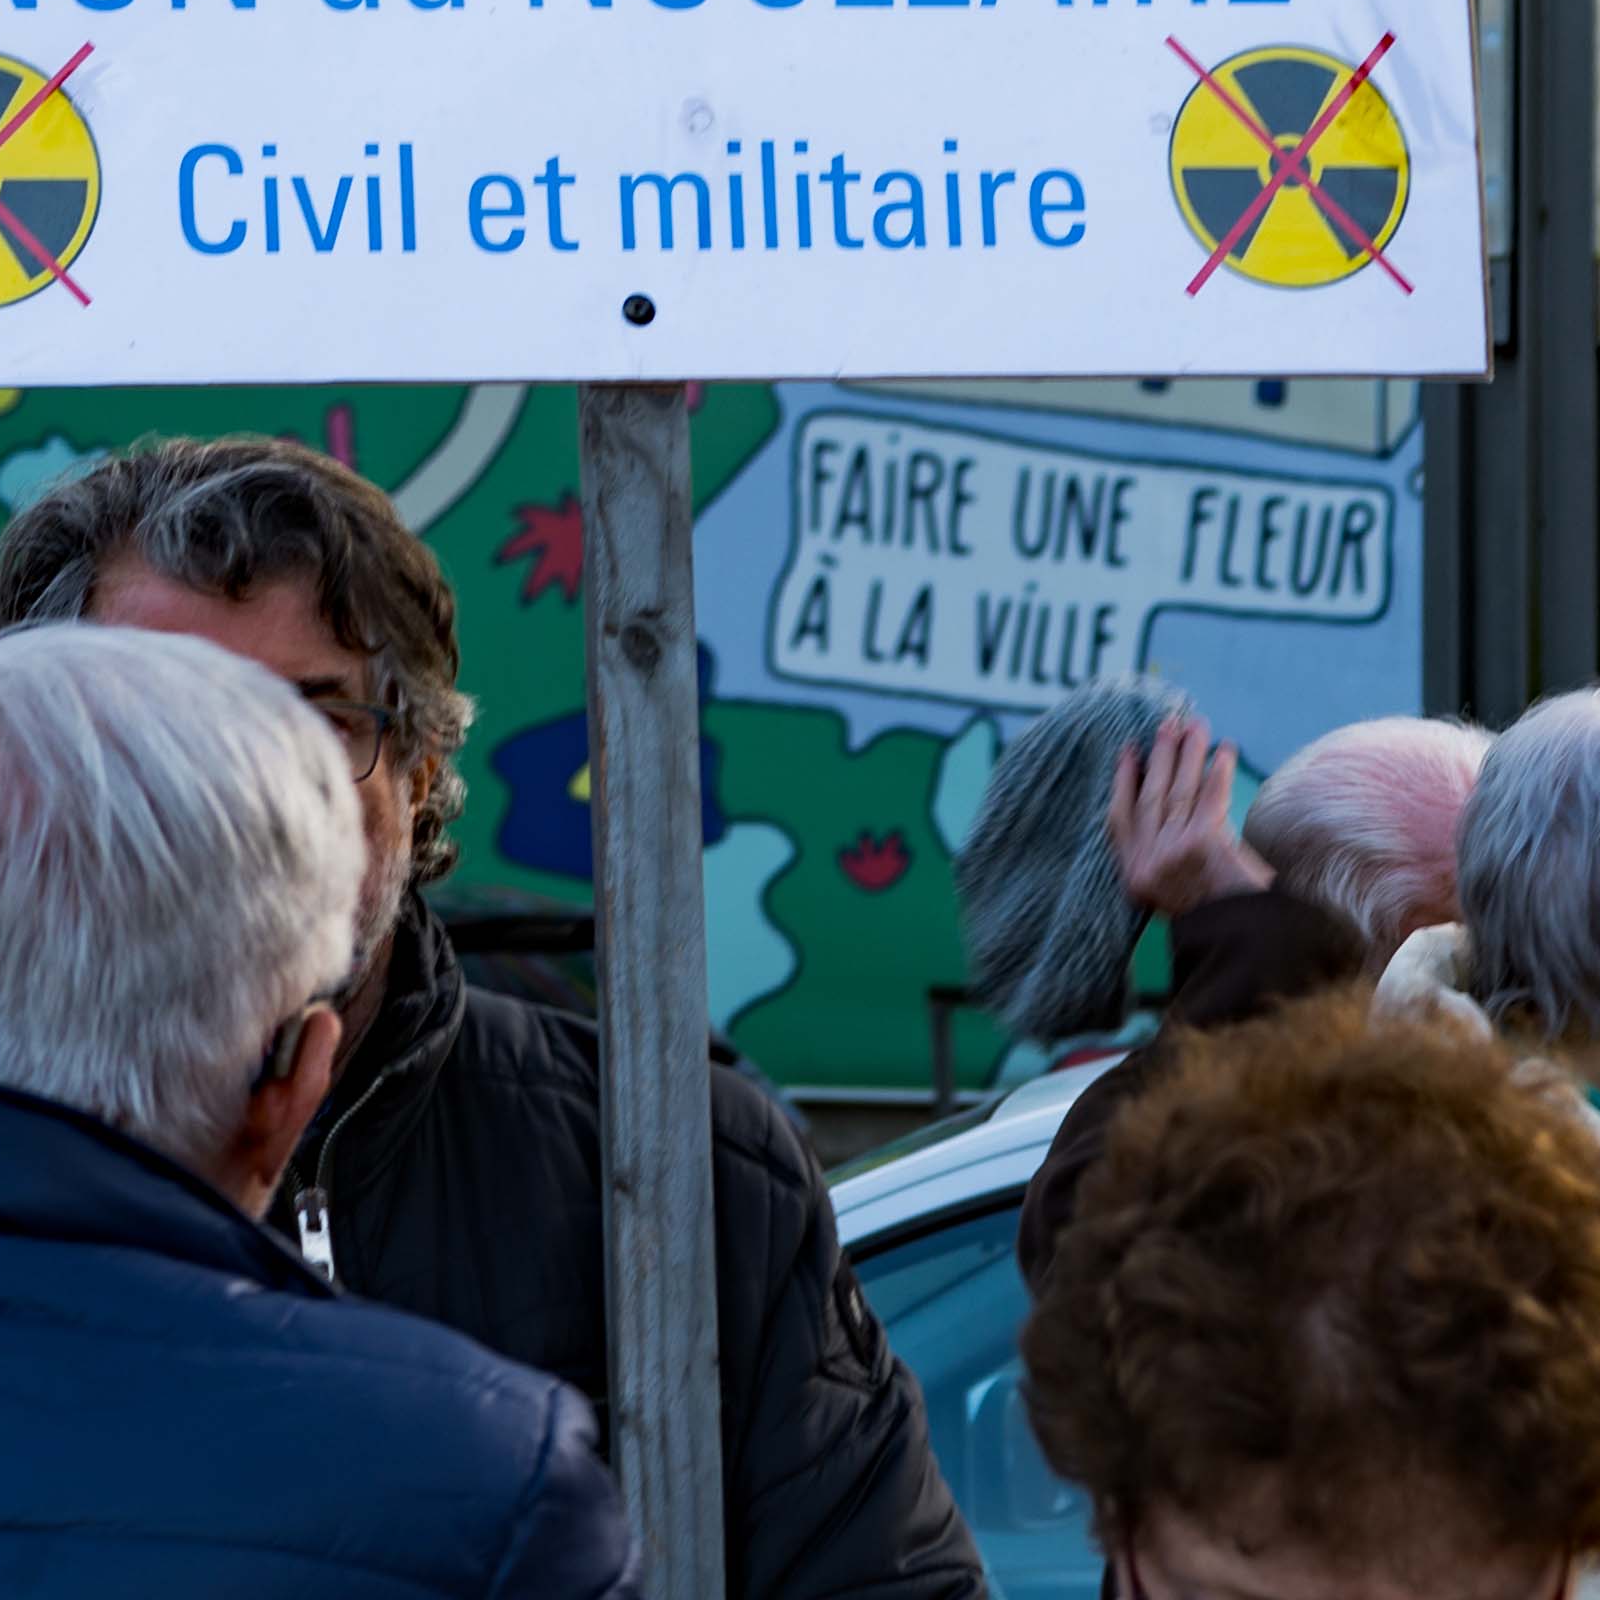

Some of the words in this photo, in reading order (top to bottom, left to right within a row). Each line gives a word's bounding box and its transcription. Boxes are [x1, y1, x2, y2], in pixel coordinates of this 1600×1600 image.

[177, 142, 417, 256] Civil
[467, 155, 580, 254] et
[618, 138, 1088, 252] militaire
[1013, 467, 1135, 568] UNE
[1180, 485, 1377, 597] FLEUR
[790, 554, 836, 653] À
[863, 580, 934, 668] LA
